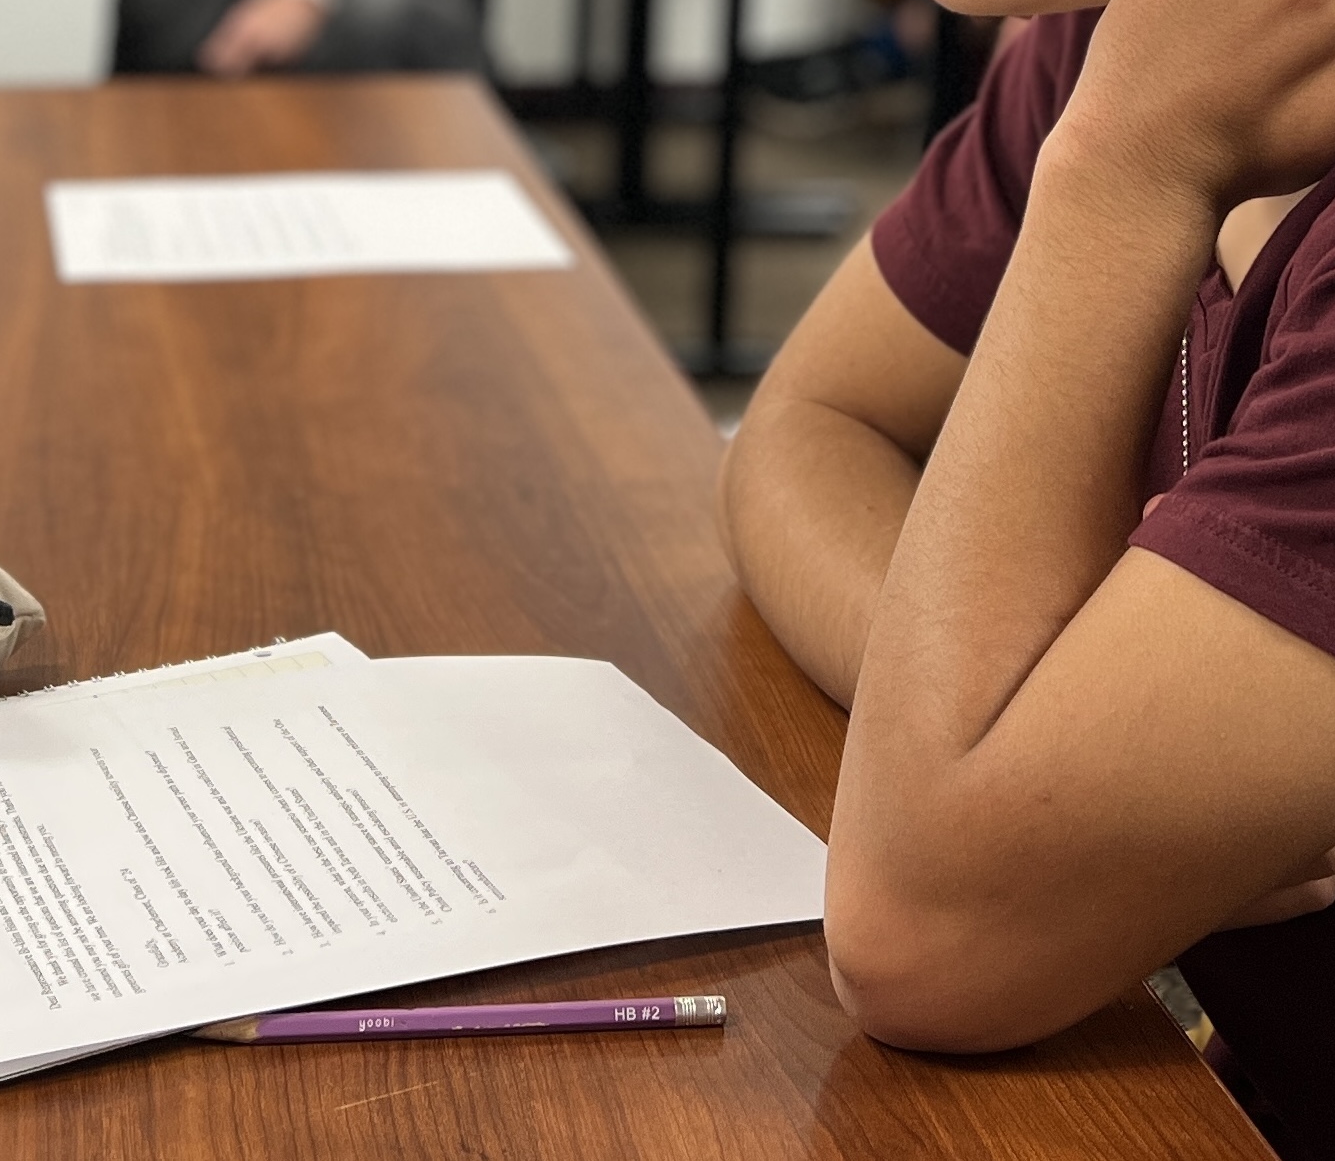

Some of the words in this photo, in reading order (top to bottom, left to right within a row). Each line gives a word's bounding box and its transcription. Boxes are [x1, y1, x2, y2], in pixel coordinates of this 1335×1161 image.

[614, 1006, 637, 1022] HB
[641, 1006, 660, 1021] #2
[358, 1016, 395, 1033] yoobi
